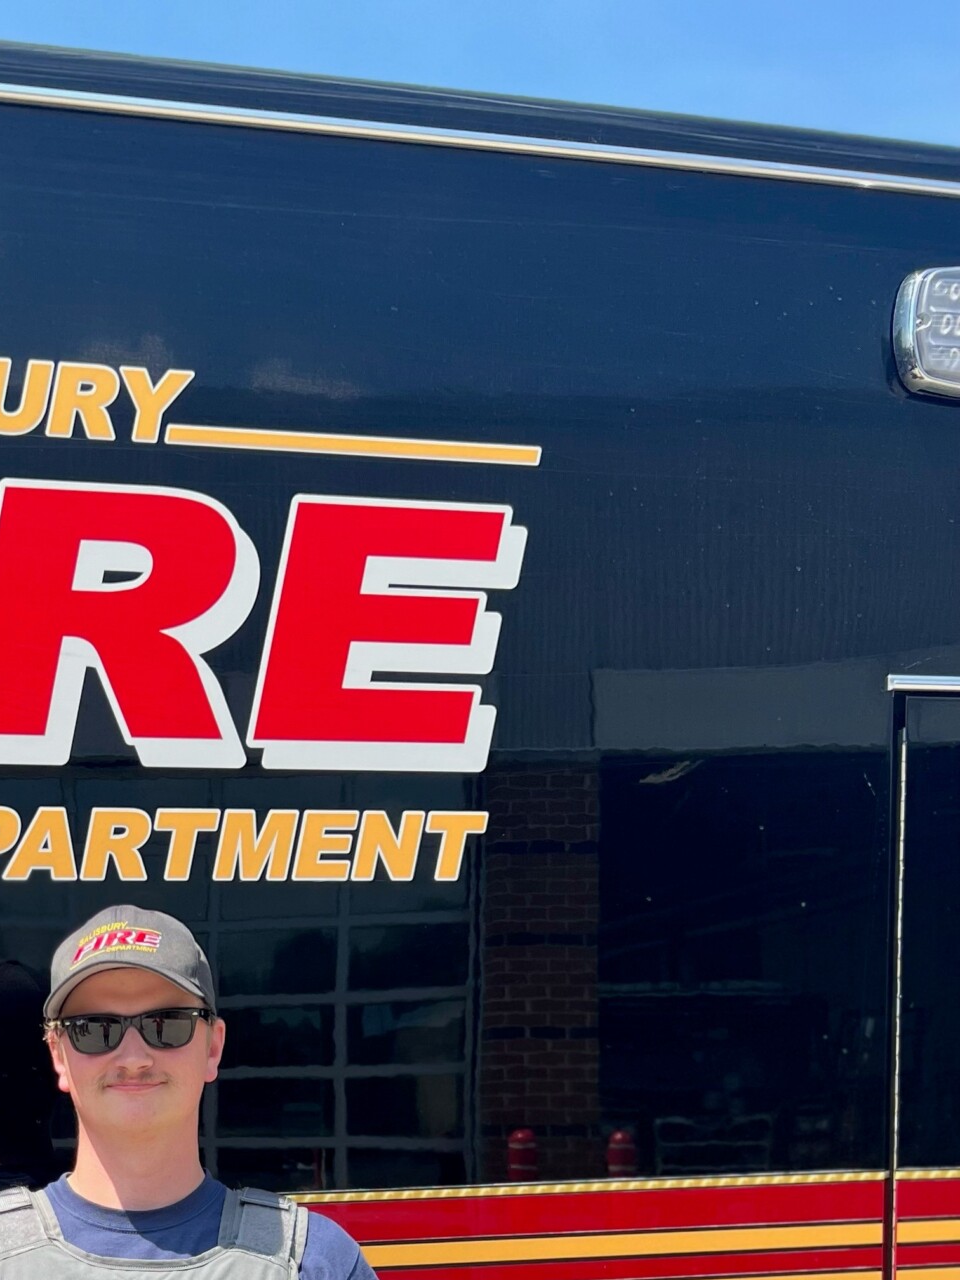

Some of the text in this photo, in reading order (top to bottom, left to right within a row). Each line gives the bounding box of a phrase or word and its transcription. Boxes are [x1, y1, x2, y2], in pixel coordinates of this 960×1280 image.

[72, 929, 162, 965] FIRE
[78, 921, 128, 947] SALISBURY
[105, 944, 158, 954] DEPARTMENT
